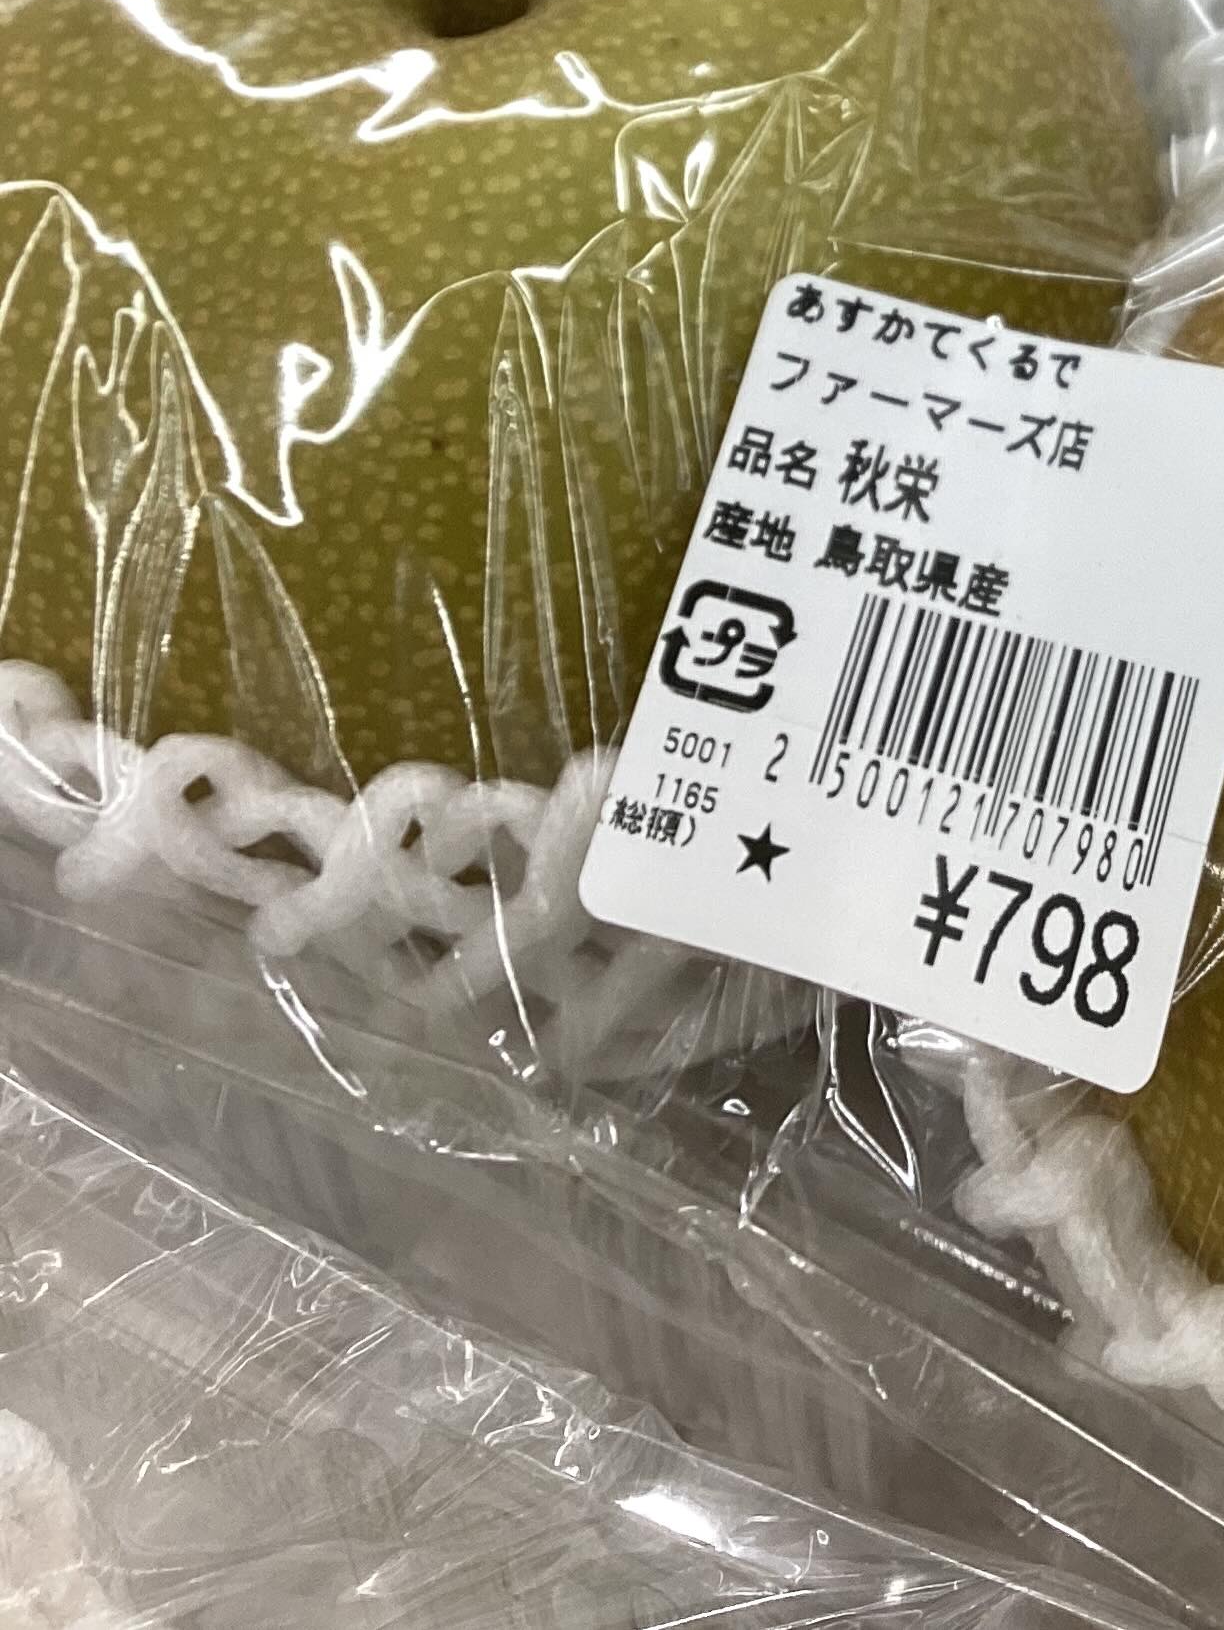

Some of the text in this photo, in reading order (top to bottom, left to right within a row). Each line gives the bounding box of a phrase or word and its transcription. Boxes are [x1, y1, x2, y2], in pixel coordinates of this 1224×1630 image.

[786, 283, 1081, 389] あすかてくるで
[770, 351, 1094, 472] ファーマーズ店
[727, 425, 940, 523] 品名 秋栄
[702, 500, 1010, 618] 産地 鳥取県産
[655, 773, 720, 815] 1165
[663, 726, 732, 769] 5001
[764, 733, 789, 783] 2
[912, 853, 1140, 1029] ¥798
